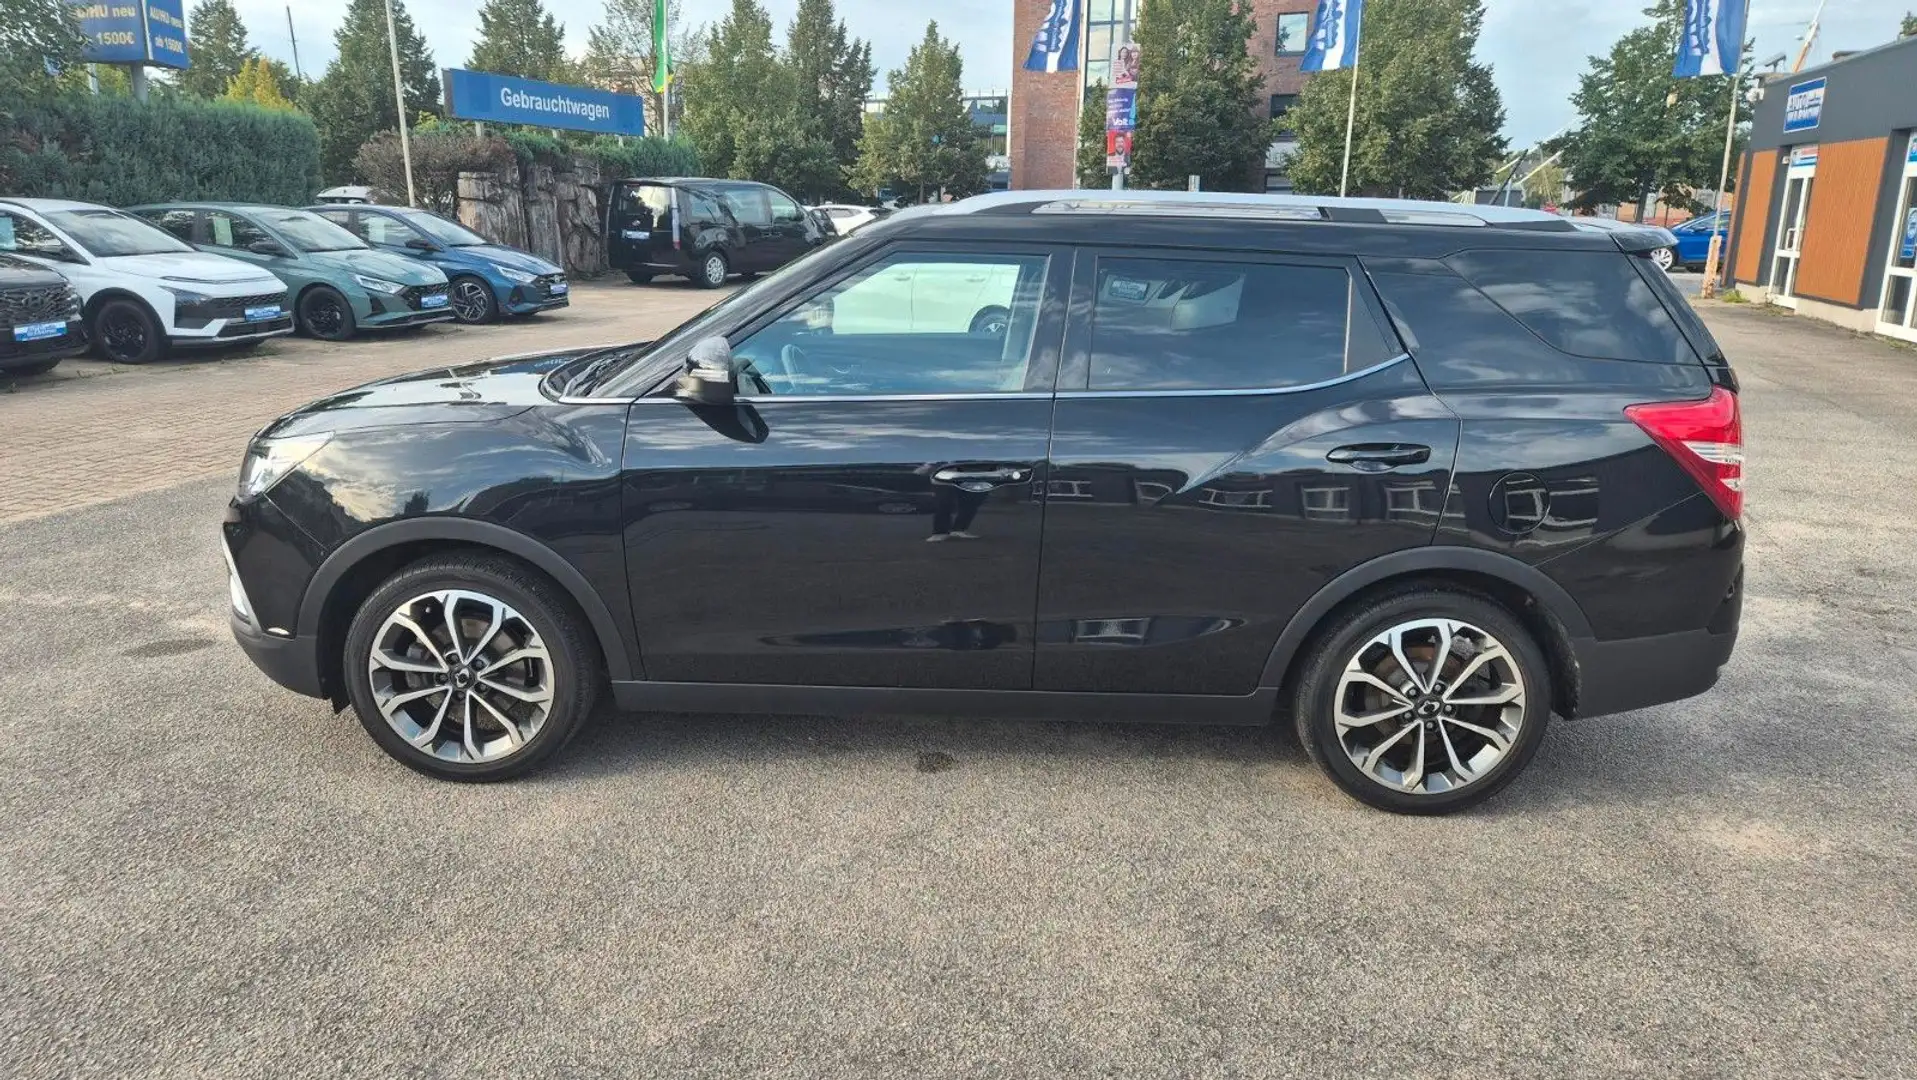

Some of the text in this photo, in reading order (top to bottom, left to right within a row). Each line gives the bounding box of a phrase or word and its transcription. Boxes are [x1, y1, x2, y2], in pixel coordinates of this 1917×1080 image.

[112, 6, 136, 17] neu
[96, 31, 135, 45] 1500€
[500, 87, 610, 120] Gebrauchtwagen
